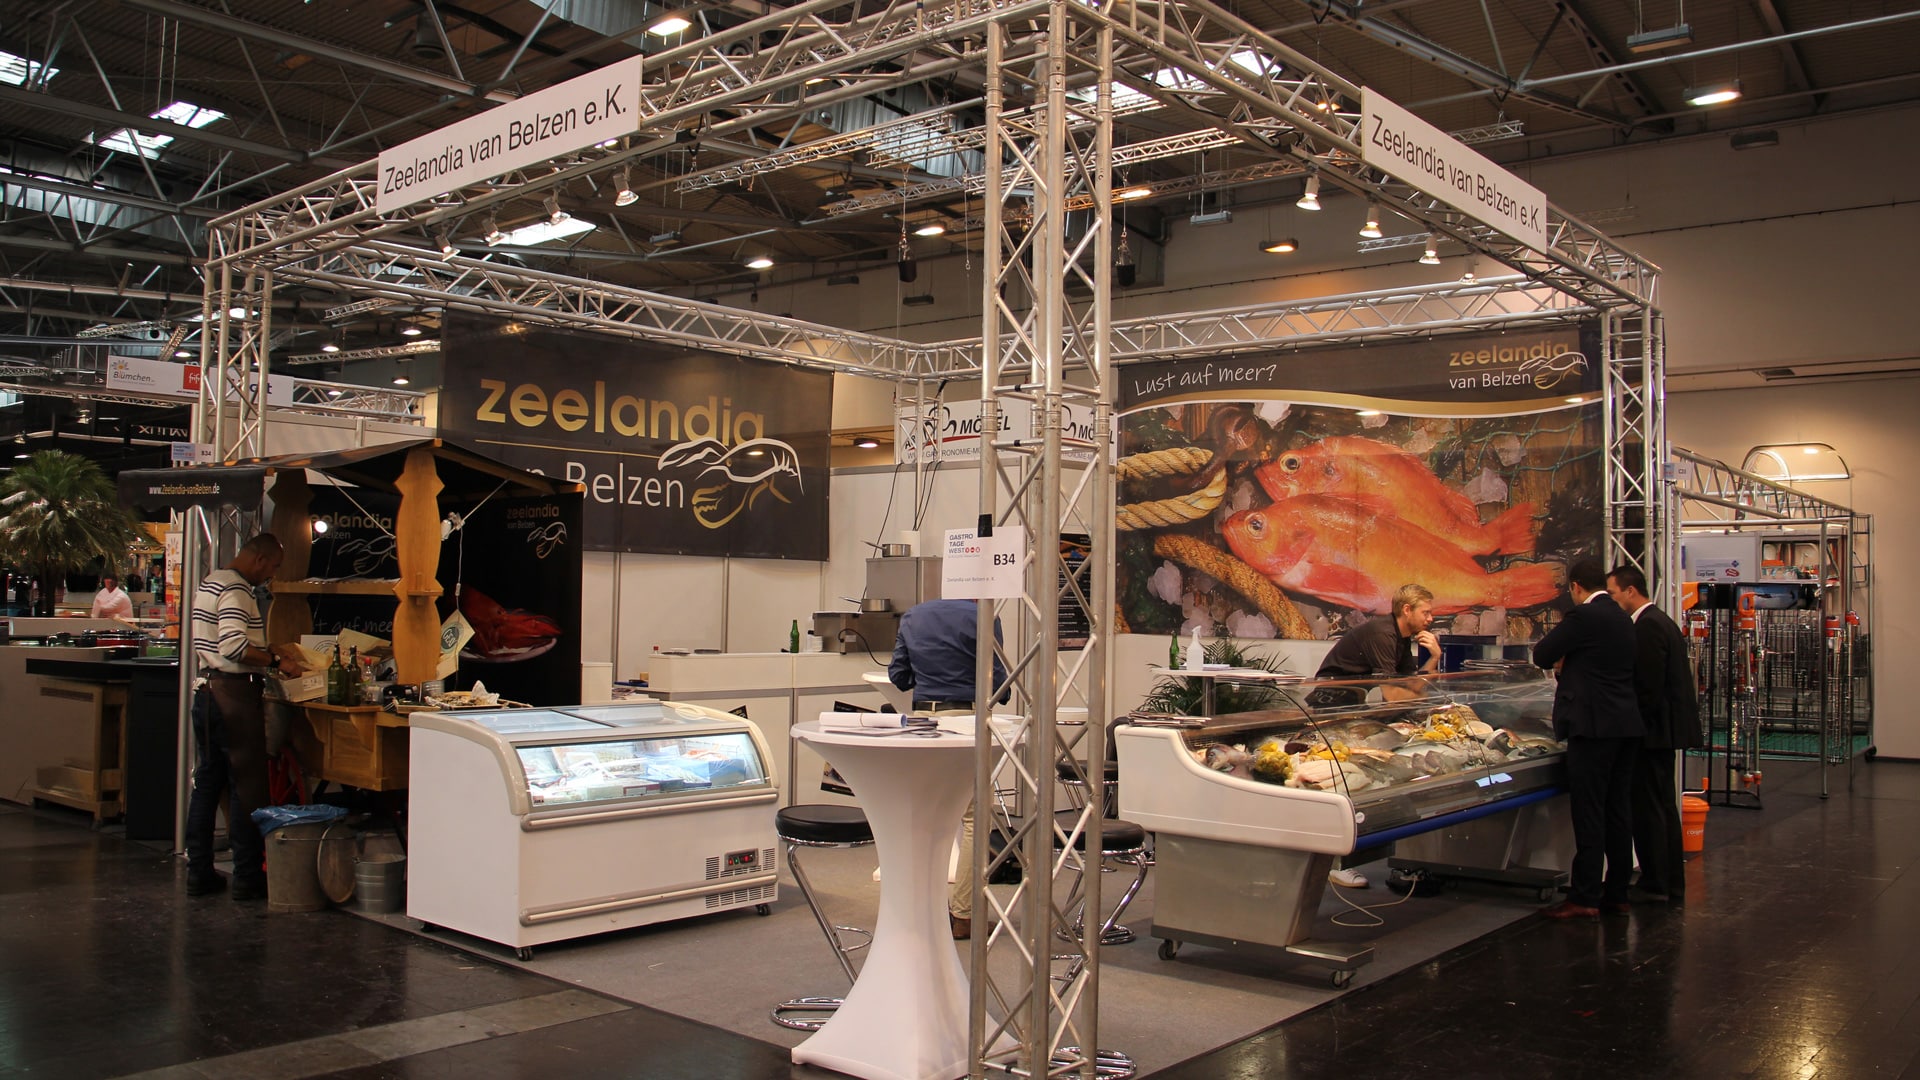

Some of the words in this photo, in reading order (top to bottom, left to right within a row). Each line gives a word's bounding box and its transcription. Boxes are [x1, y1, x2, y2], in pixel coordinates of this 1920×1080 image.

[384, 145, 463, 194] Zeelandia
[470, 134, 501, 164] van
[509, 108, 576, 151] Belzen
[584, 84, 627, 125] e.K.
[1372, 114, 1446, 181] Zeelandia
[1449, 164, 1473, 196] van
[1477, 174, 1517, 220] Belzen
[1520, 204, 1542, 234] e.K.
[1449, 340, 1569, 366] zeelandia
[1135, 372, 1176, 396] Lust
[1180, 363, 1213, 386] auf
[1219, 364, 1277, 382] meer?
[1449, 377, 1476, 389] van
[1482, 371, 1531, 387] Belzen
[476, 378, 765, 446] zeelandia
[566, 461, 684, 509] Belzen
[506, 504, 560, 520] zeelandia
[949, 533, 974, 541] GASTRO
[993, 553, 1016, 566] B34
